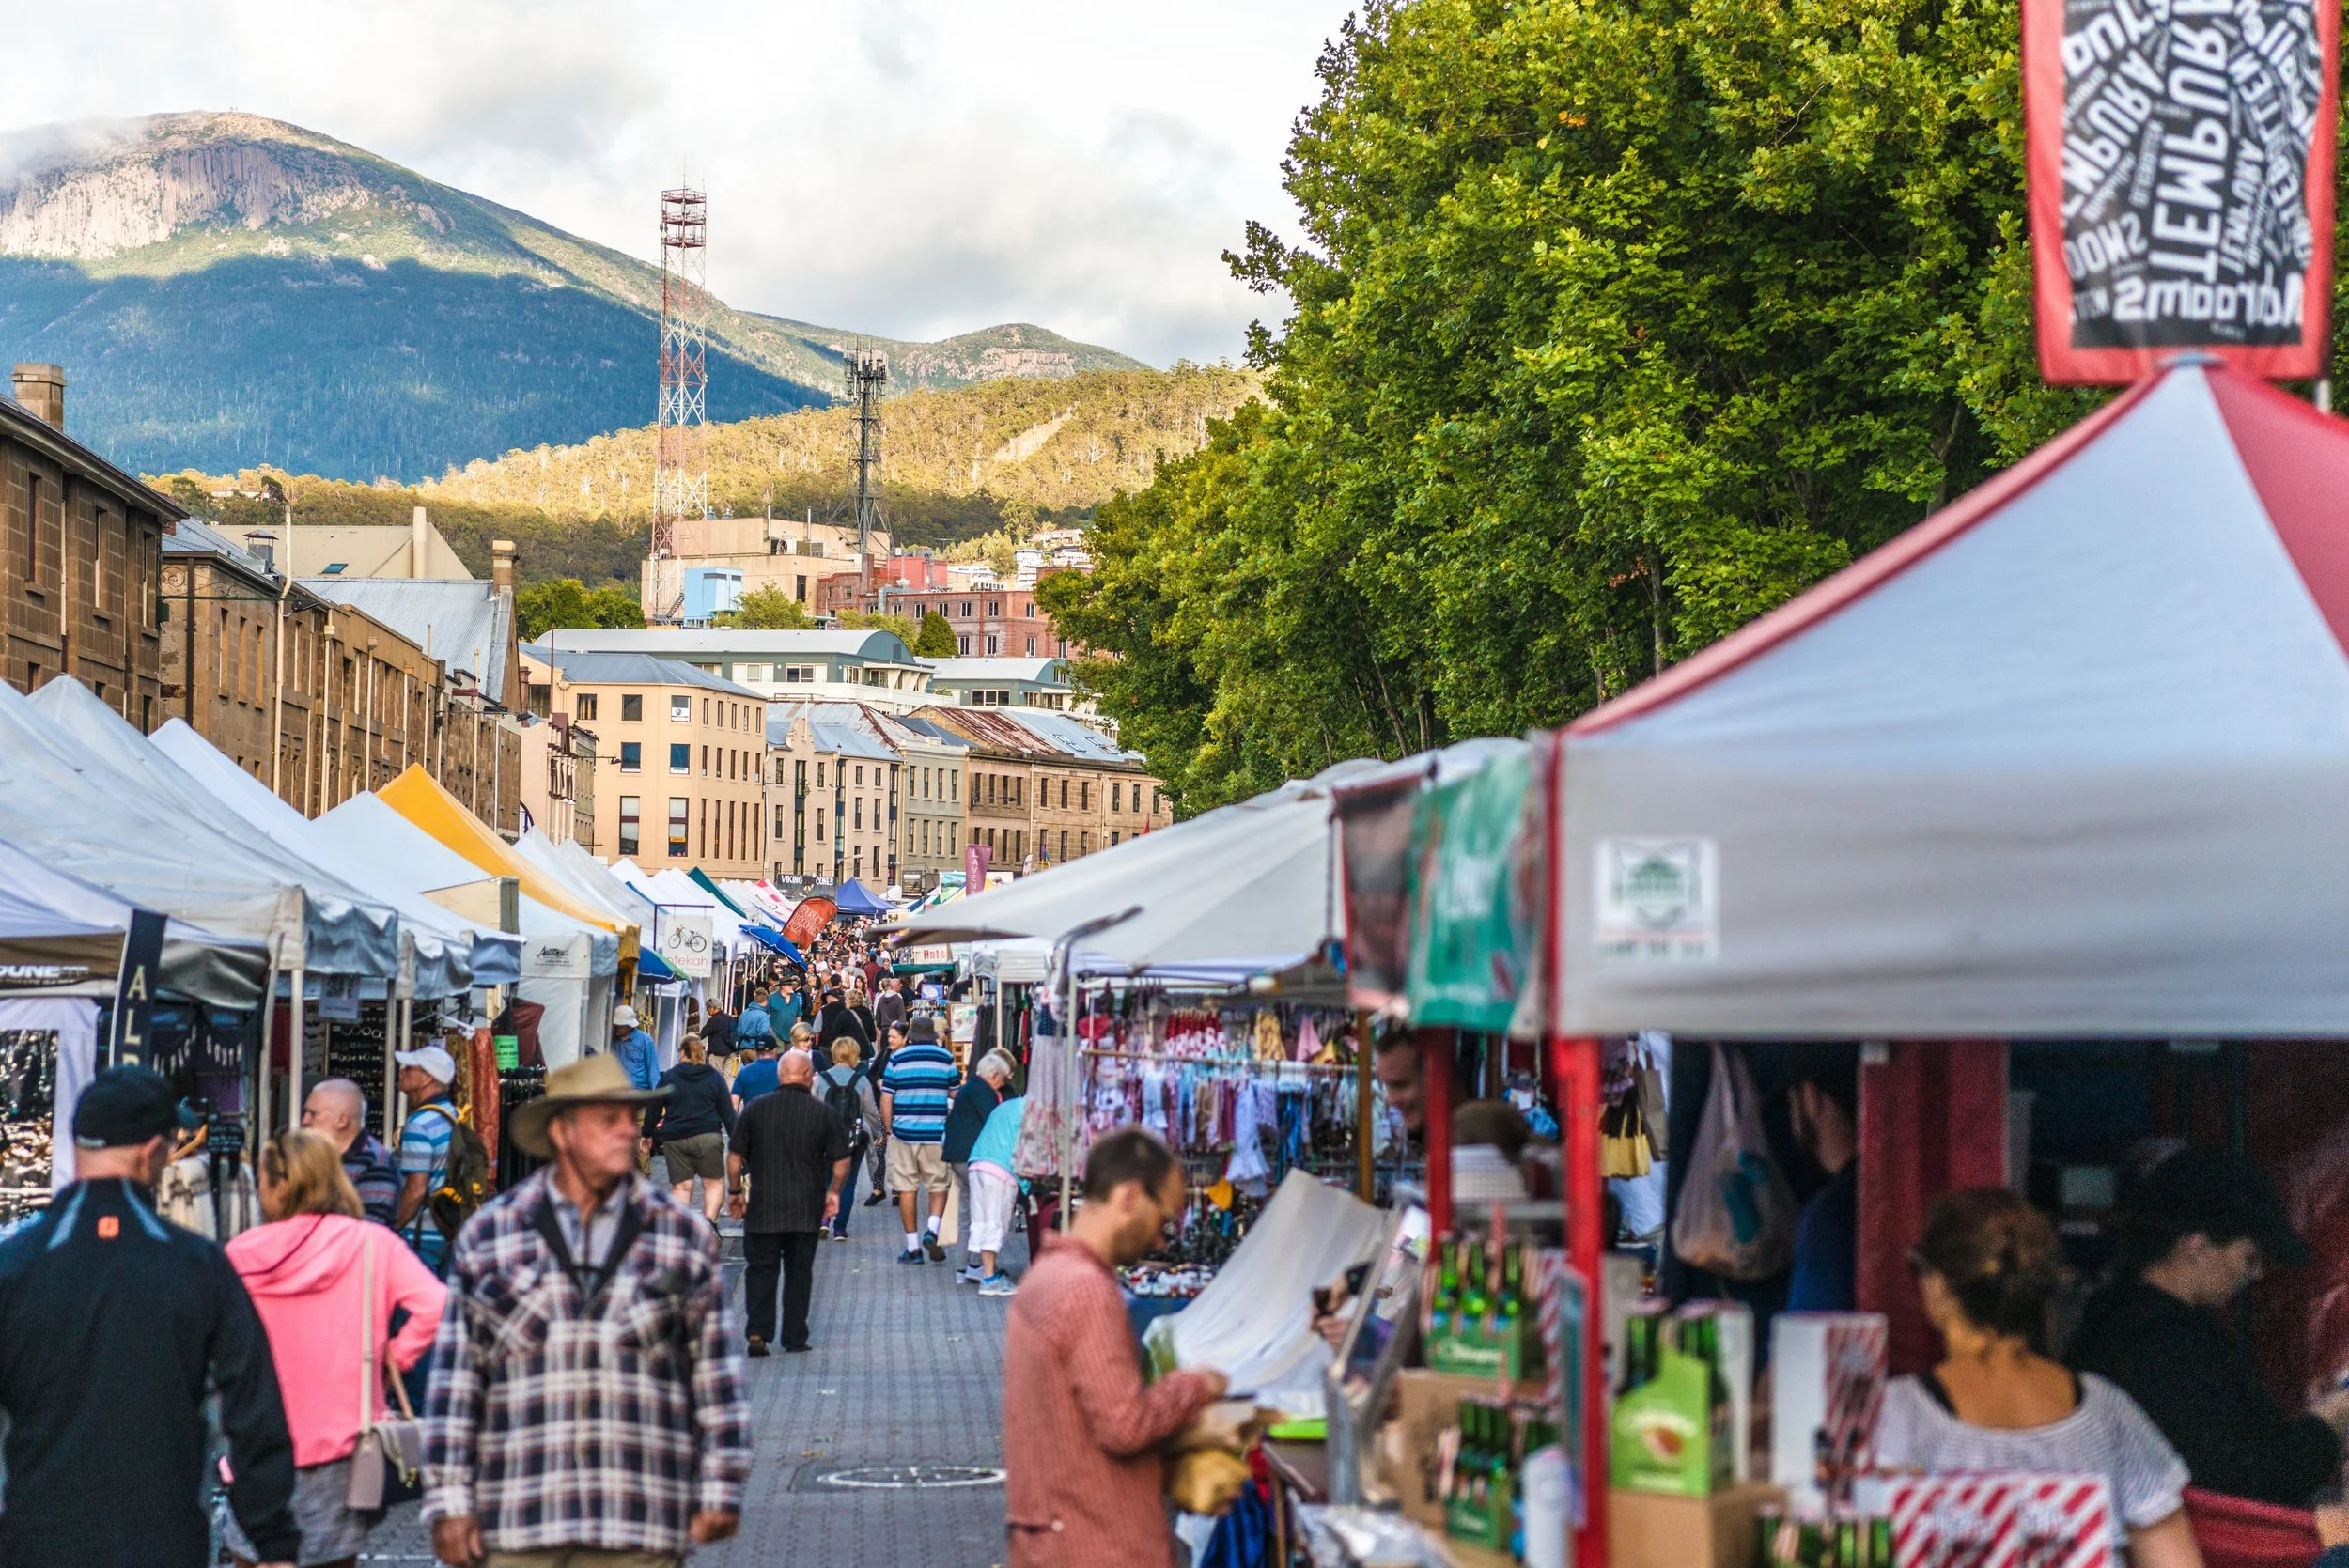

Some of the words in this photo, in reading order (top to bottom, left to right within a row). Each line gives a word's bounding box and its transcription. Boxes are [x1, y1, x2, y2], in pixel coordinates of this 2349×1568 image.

[781, 875, 803, 884] VIKING
[815, 877, 834, 886] CONES
[923, 949, 946, 960] Hats
